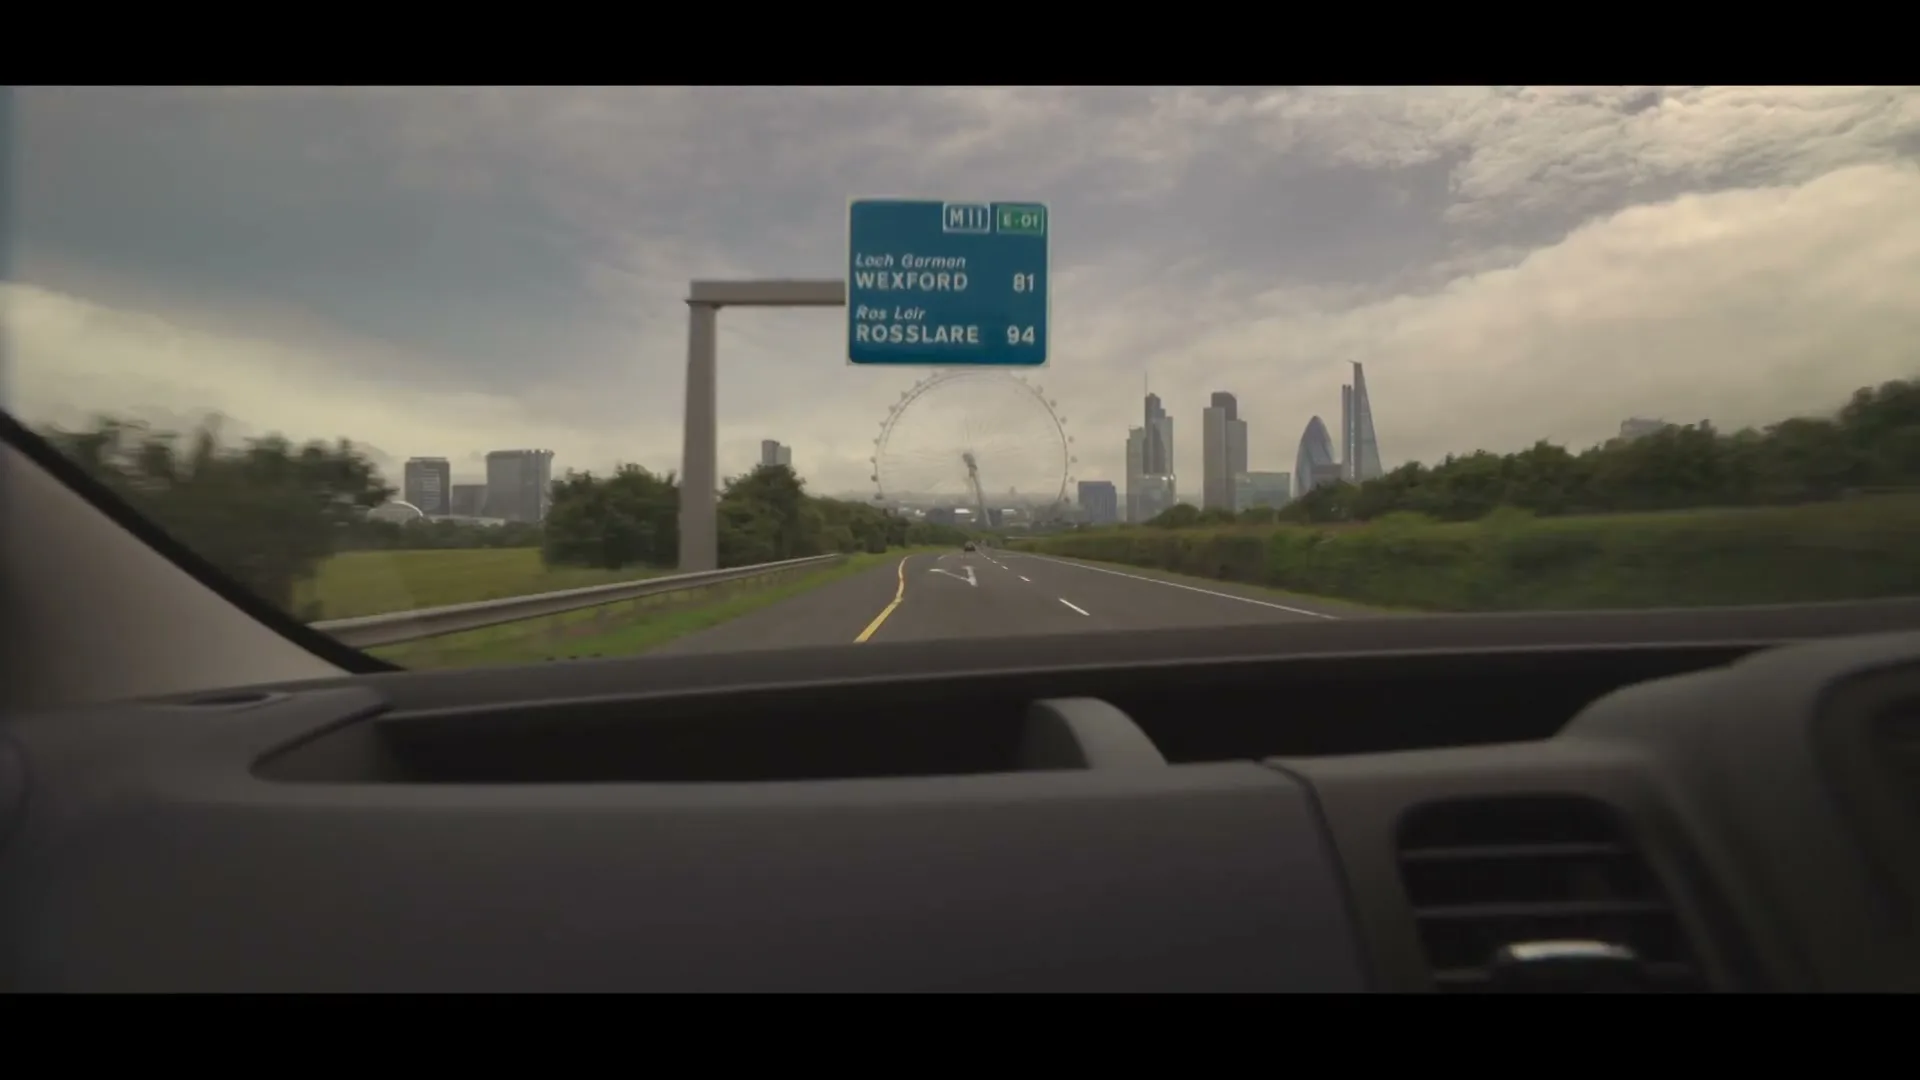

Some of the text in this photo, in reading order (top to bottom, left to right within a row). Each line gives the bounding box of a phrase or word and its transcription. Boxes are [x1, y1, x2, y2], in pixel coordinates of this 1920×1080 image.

[950, 208, 982, 228] M11
[855, 253, 893, 267] Loch
[855, 272, 1034, 292] WEXFORD 81
[856, 304, 887, 320] Ros
[856, 324, 1035, 344] ROSSLARE 94
